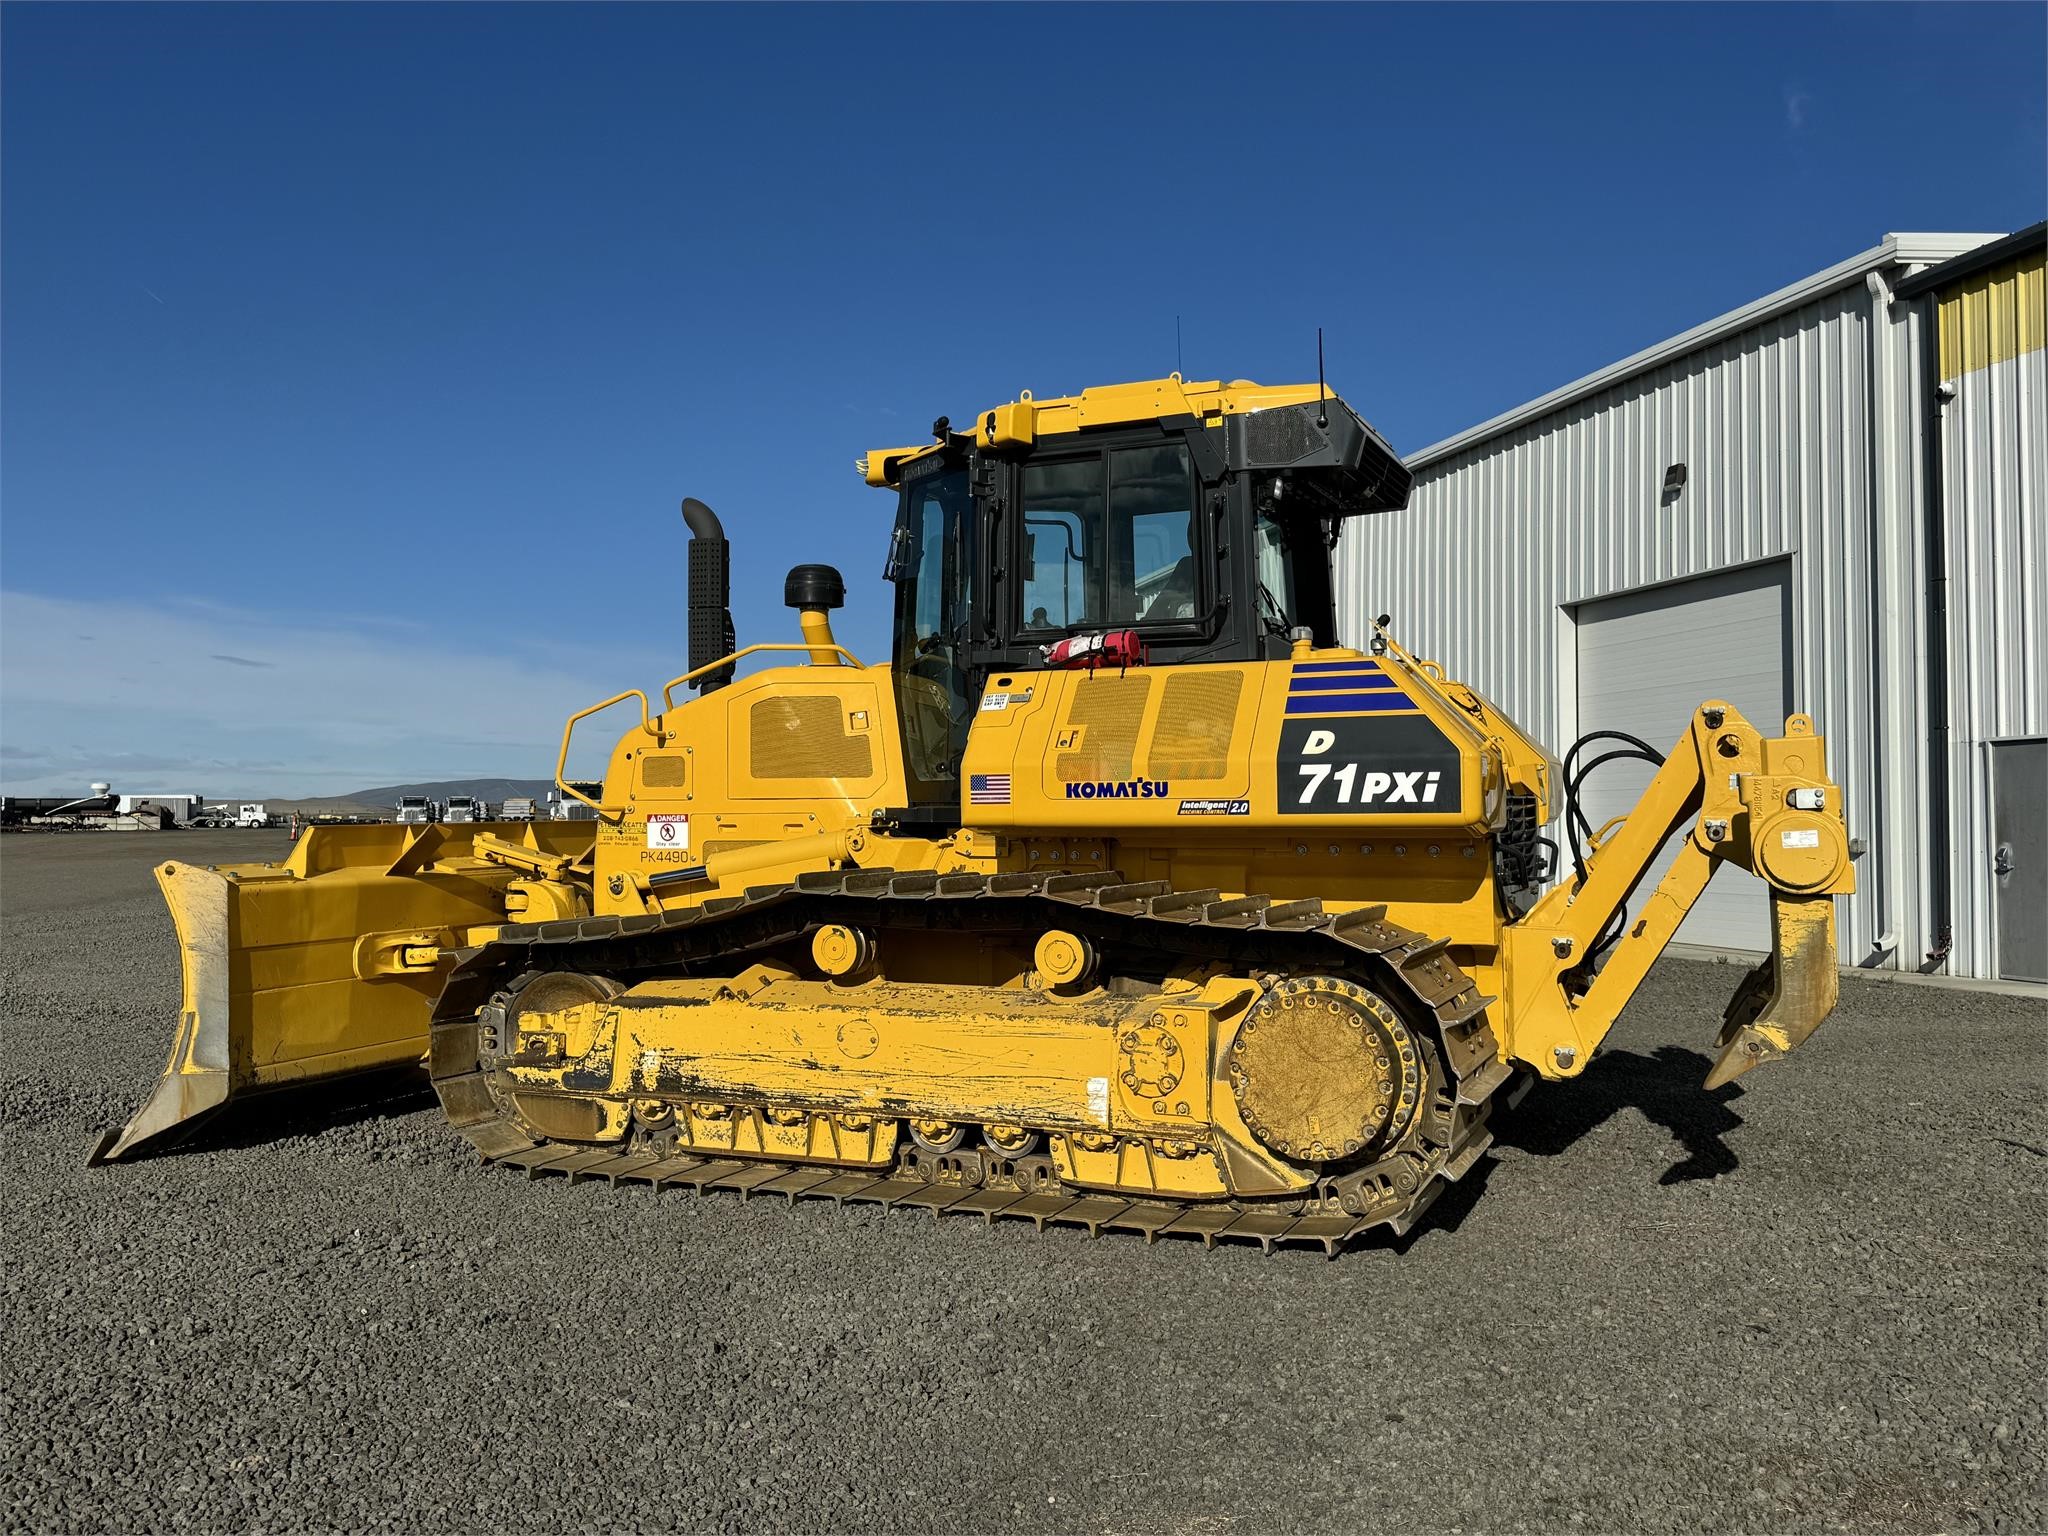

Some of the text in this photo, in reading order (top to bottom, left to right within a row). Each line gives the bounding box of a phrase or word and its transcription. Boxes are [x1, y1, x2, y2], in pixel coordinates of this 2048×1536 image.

[1301, 730, 1336, 755] D
[1065, 777, 1169, 798] KOMATSU
[1182, 801, 1248, 813] Intelligent 2.0
[640, 851, 688, 863] PK4490
